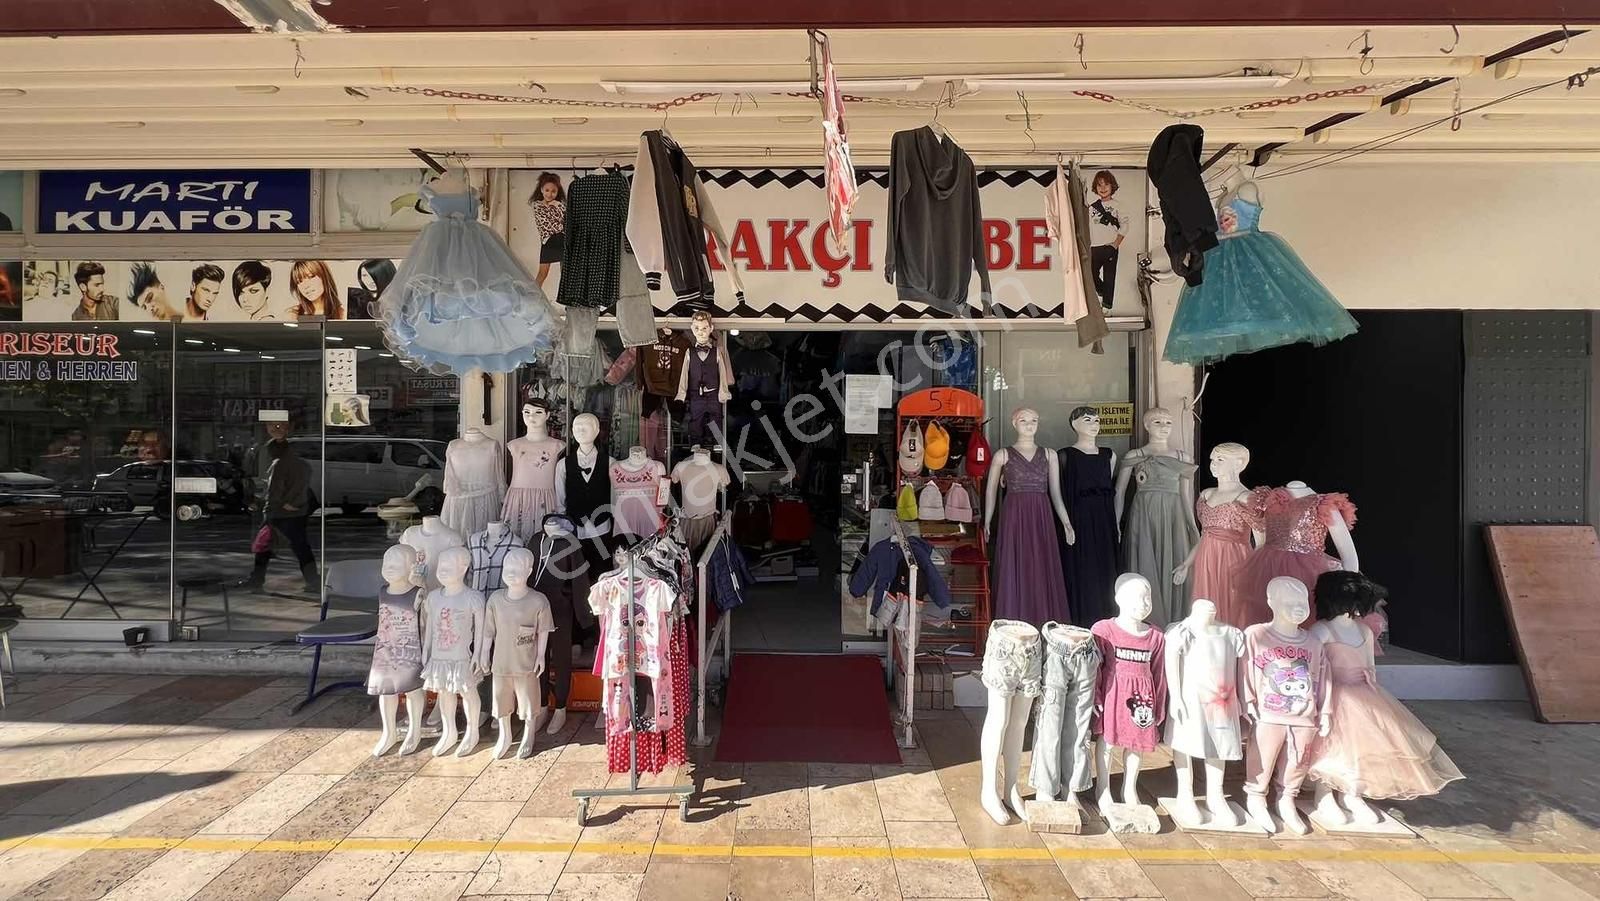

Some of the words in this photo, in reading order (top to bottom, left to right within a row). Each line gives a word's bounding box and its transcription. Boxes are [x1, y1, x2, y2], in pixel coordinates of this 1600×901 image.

[55, 206, 296, 232] KUAFÖR
[37, 361, 52, 380] &
[57, 361, 138, 381] HERREN
[1101, 406, 1130, 415] İŞLETME
